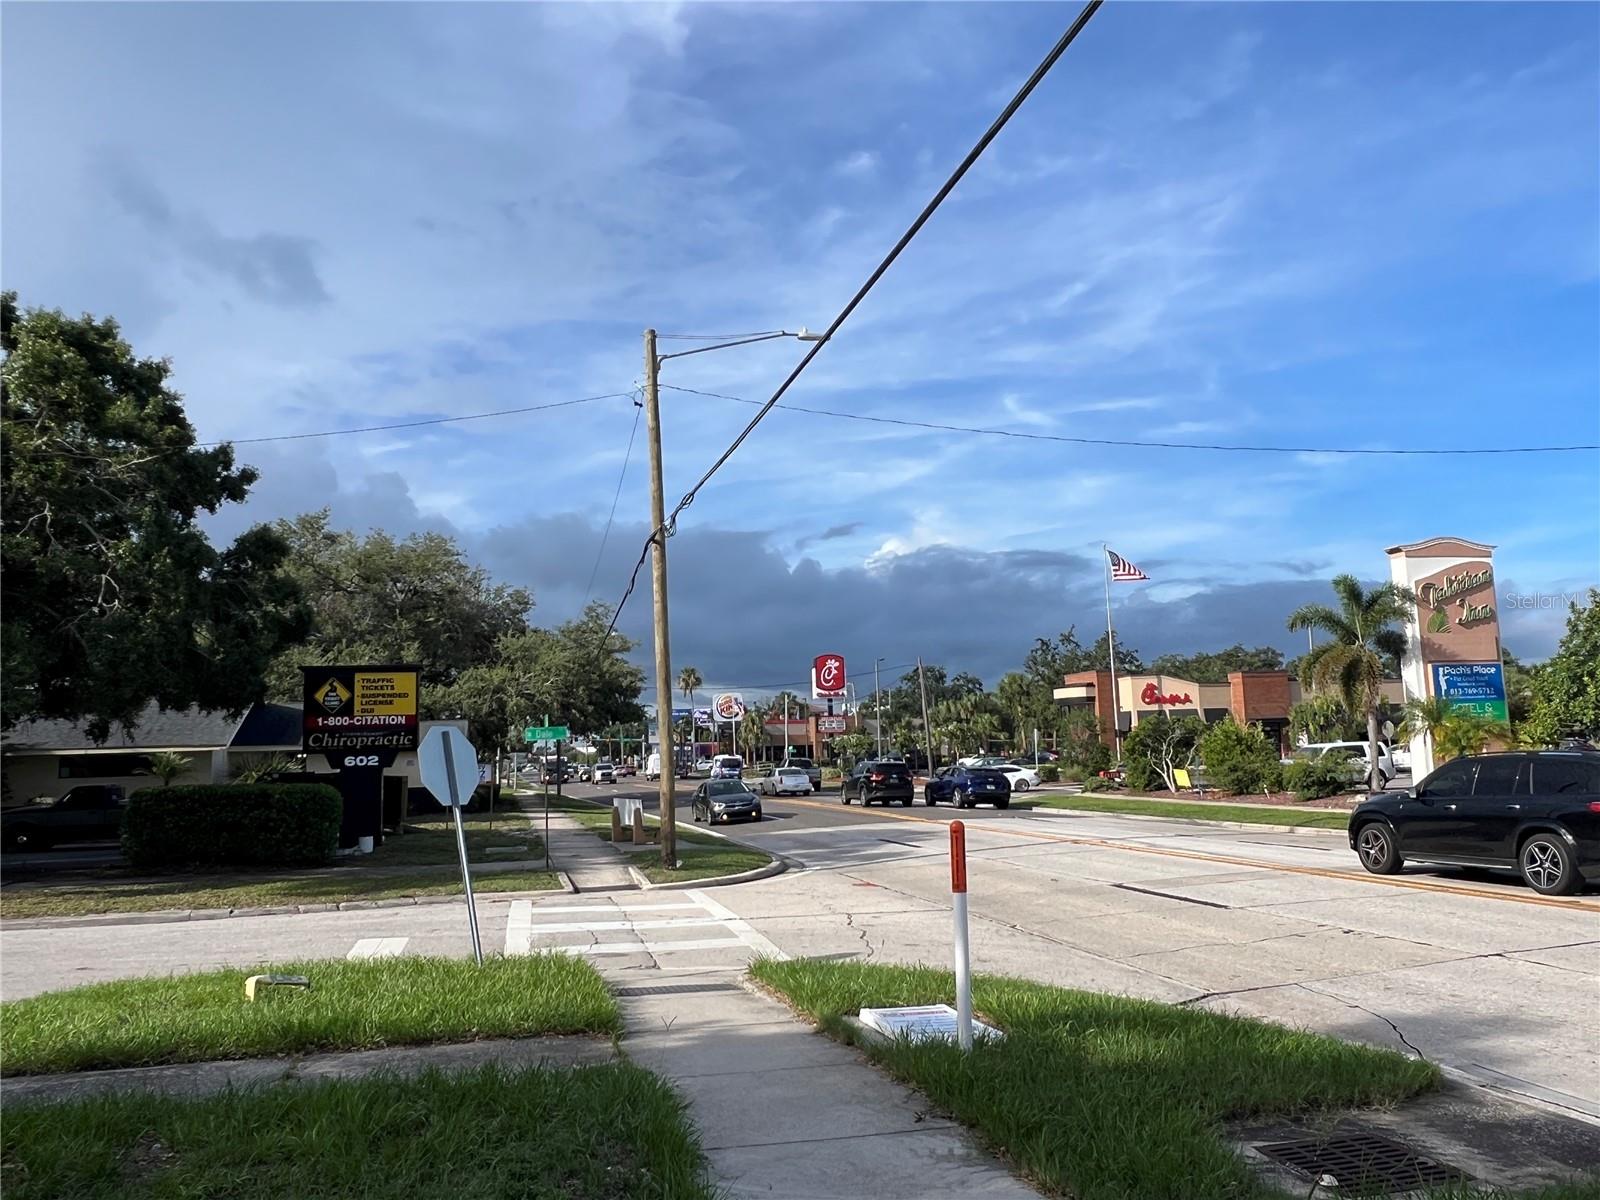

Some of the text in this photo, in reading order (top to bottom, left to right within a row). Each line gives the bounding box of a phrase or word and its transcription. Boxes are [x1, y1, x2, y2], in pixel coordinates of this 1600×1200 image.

[1472, 666, 1496, 674] Place
[317, 716, 406, 726] 1-800-CITATION
[308, 732, 413, 749] Chiropractic
[344, 756, 379, 766] 602
